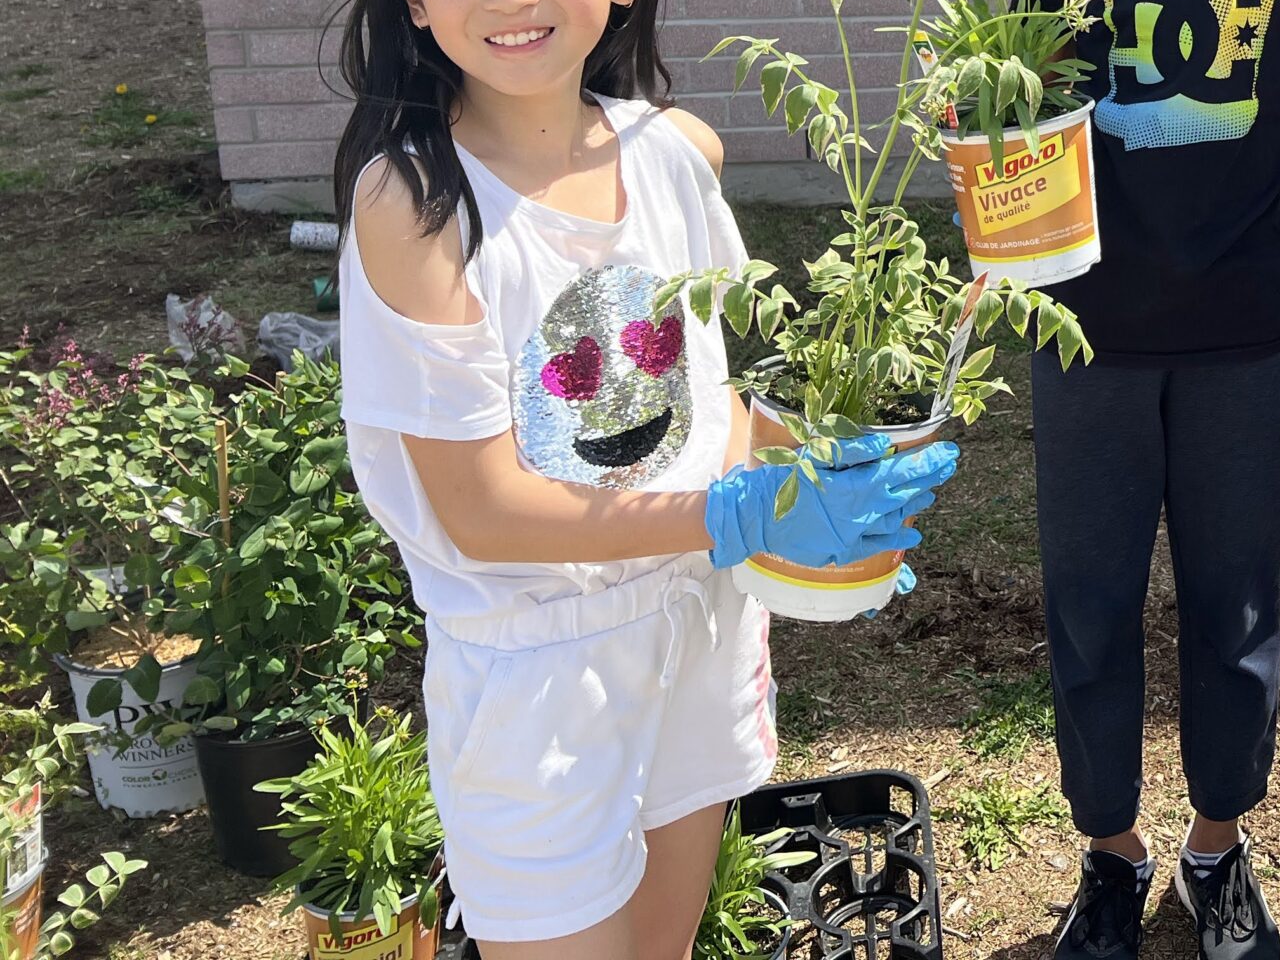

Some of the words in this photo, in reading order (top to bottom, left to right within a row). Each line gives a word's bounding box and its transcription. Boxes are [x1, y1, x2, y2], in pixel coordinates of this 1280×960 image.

[982, 143, 1056, 182] Vgoro
[978, 177, 1047, 212] Vivace
[983, 215, 994, 224] de
[997, 202, 1031, 221] qualité
[999, 238, 1040, 249] JARDINAGE
